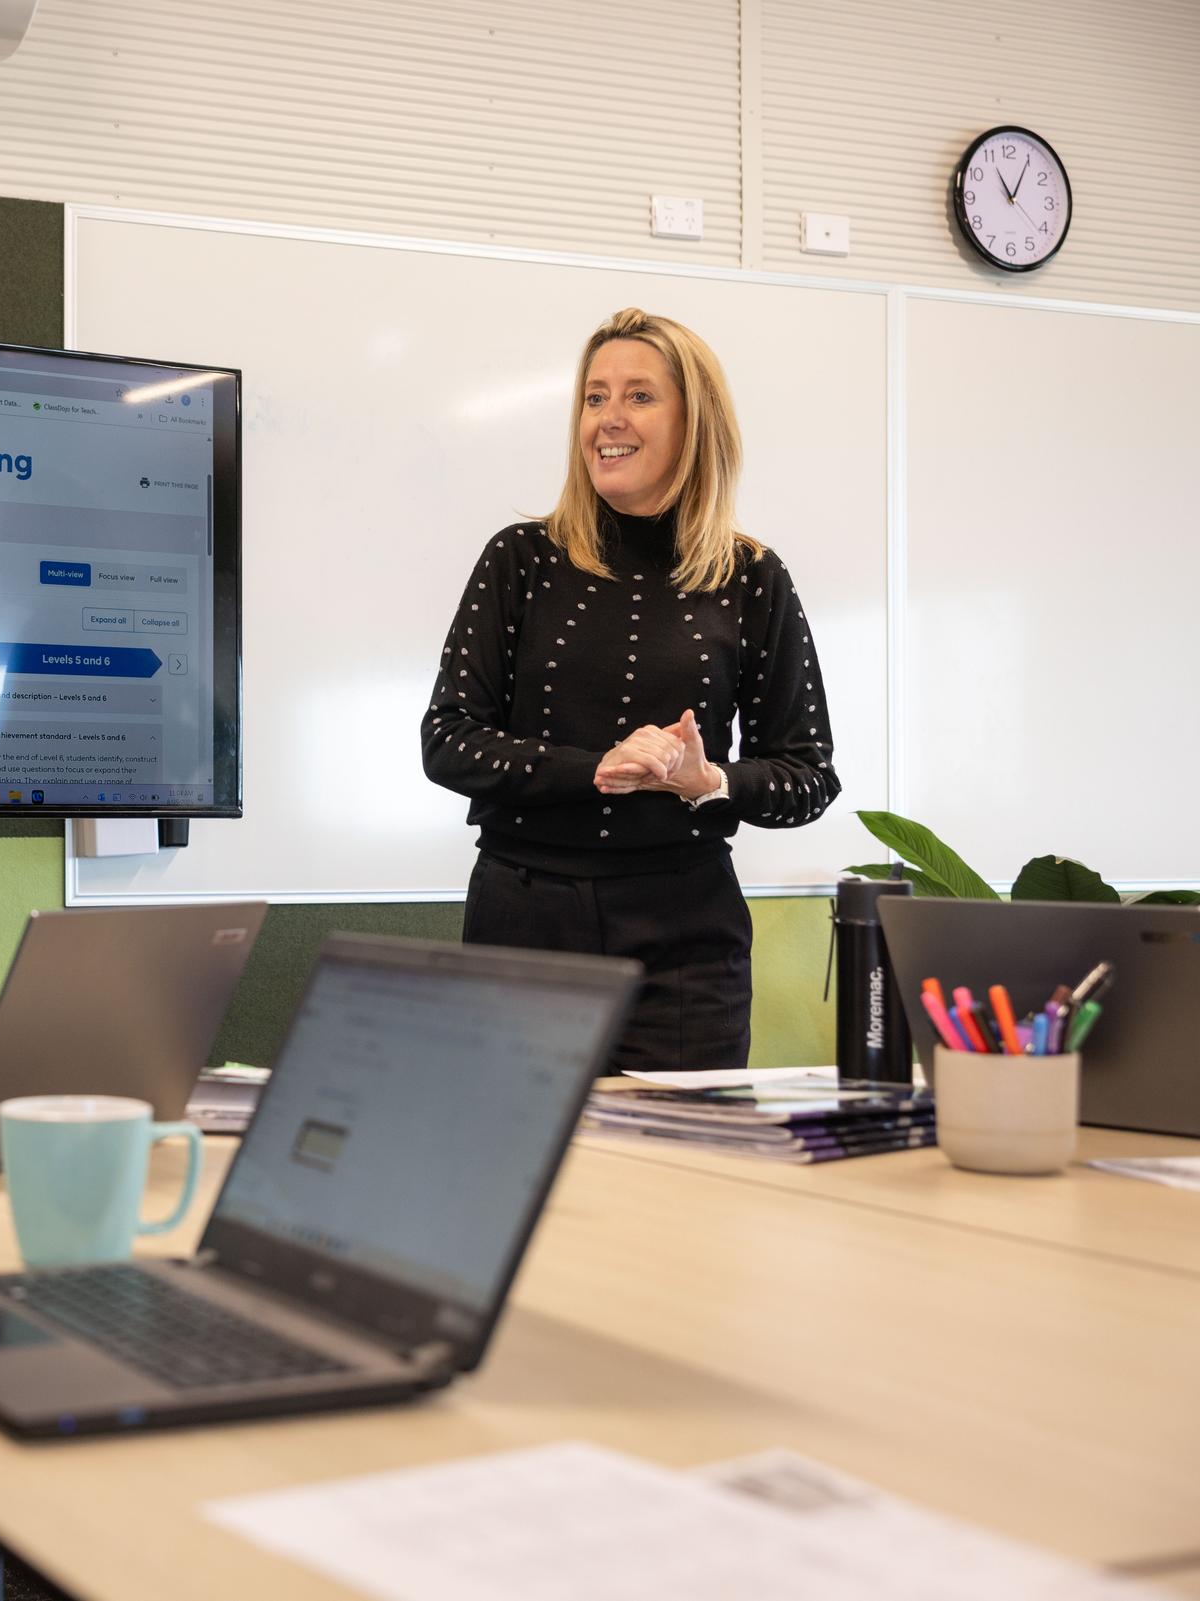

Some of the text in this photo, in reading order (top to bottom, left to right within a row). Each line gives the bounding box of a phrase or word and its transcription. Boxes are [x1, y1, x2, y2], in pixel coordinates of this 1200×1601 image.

[984, 148, 995, 163] 11
[1002, 144, 1016, 160] 12
[969, 167, 984, 181] 10
[1037, 172, 1048, 186] 2
[964, 190, 976, 205] 9
[1044, 196, 1054, 211] 3
[972, 215, 983, 230] 8
[1039, 221, 1048, 235] 4
[986, 235, 996, 249] 7
[1024, 236, 1035, 251] 5
[1005, 242, 1016, 257] 6
[71, 405, 80, 414] for
[47, 569, 84, 579] Multi-view
[98, 572, 136, 582] Focus view
[90, 615, 127, 625] Expand all
[141, 618, 180, 628] Collapse all
[42, 654, 111, 666] Levels 5 and 6
[13, 692, 101, 702] description Levels and
[39, 732, 72, 741] standard
[78, 733, 101, 742] Levels
[107, 734, 121, 742] and
[4, 753, 15, 762] the
[16, 754, 30, 762] end
[39, 754, 58, 762] Level
[66, 754, 97, 763] students
[125, 755, 158, 764] construct
[21, 766, 56, 775] questions
[65, 766, 84, 774] focus
[94, 767, 120, 776] expand
[121, 766, 137, 774] their
[866, 966, 884, 1049] Moremac.
